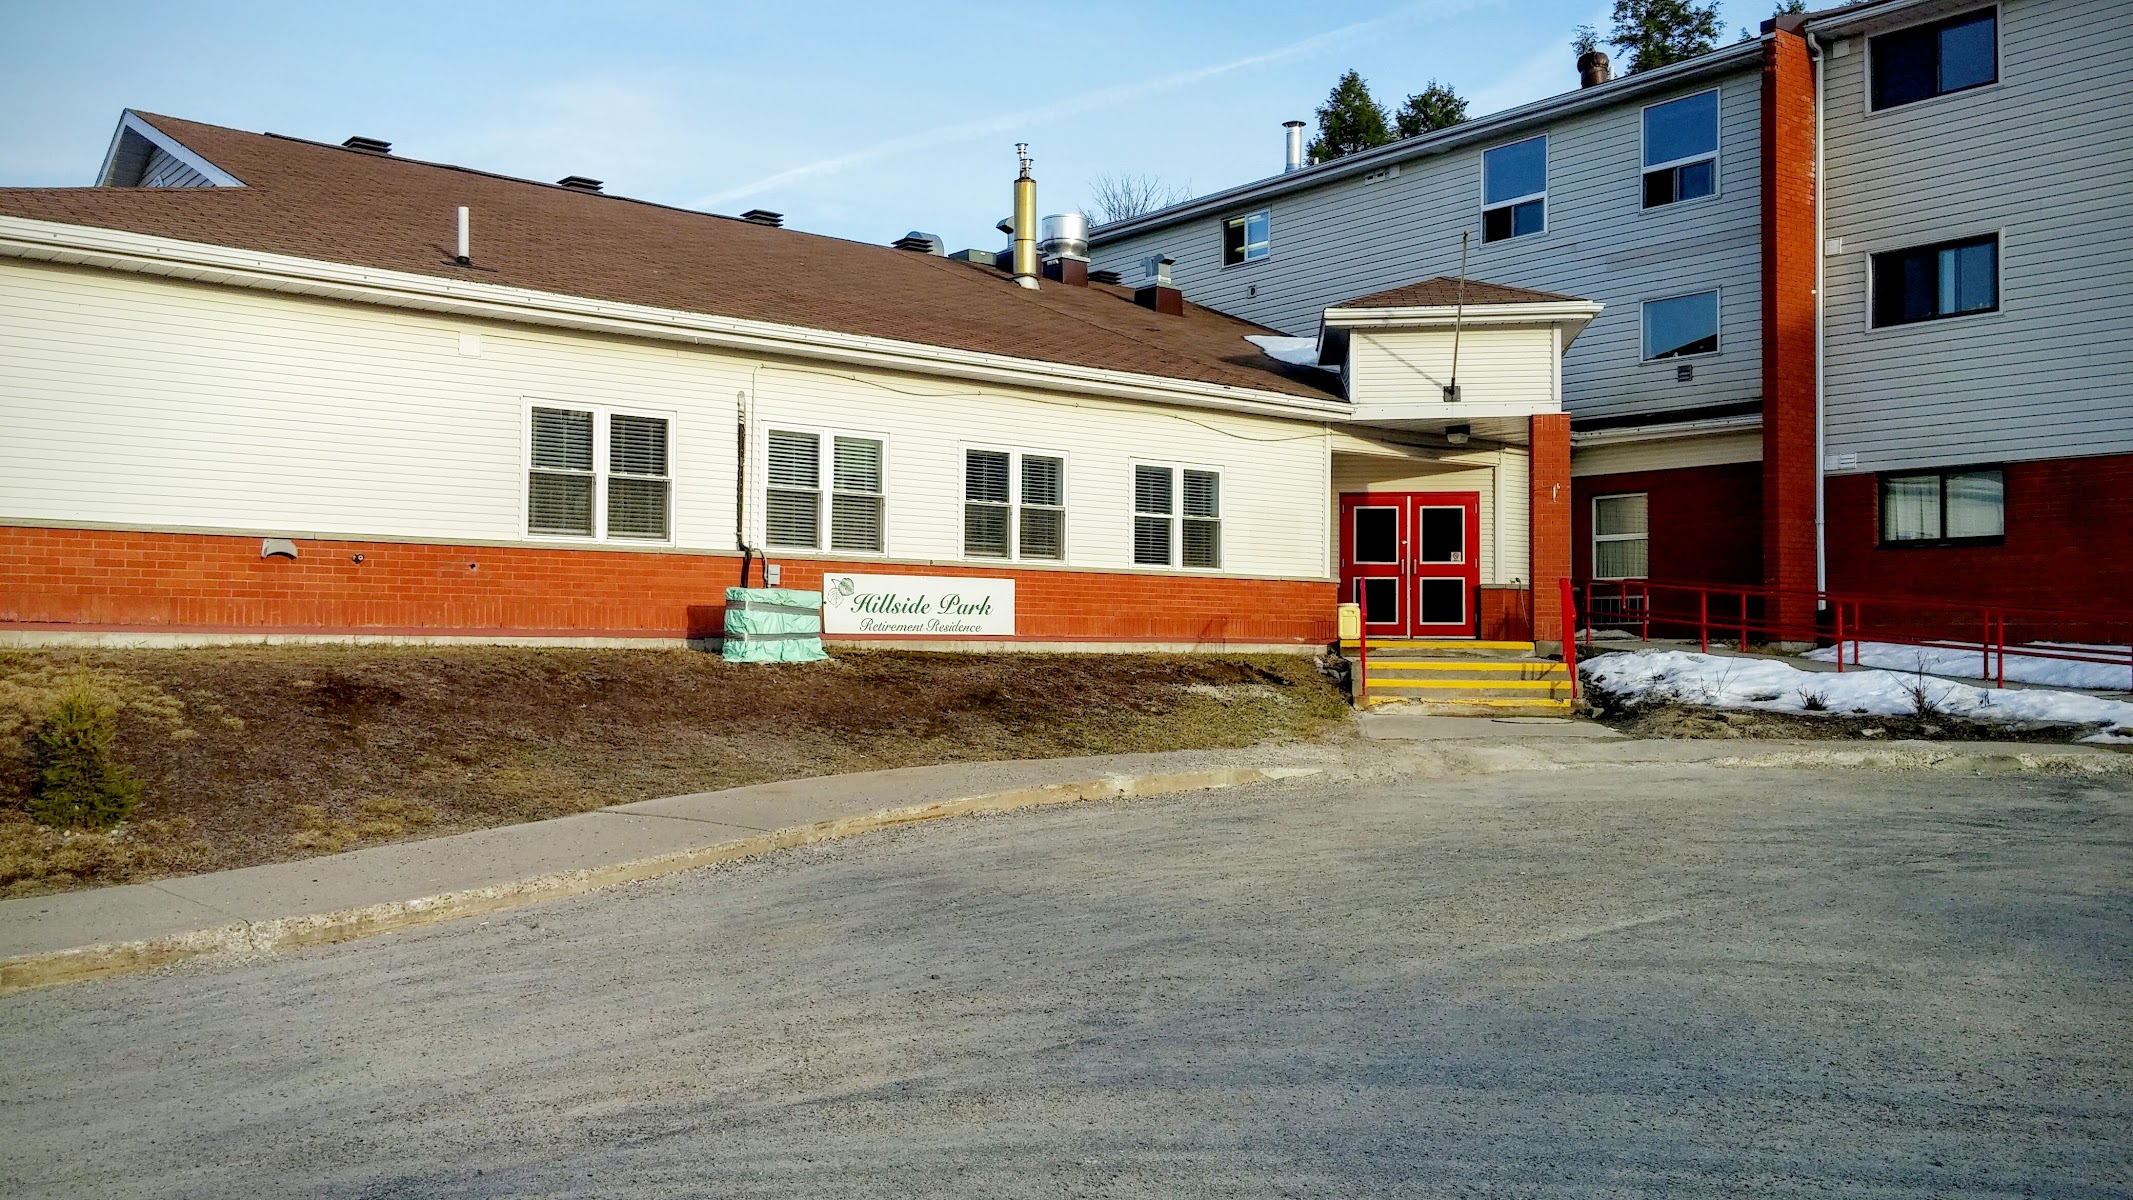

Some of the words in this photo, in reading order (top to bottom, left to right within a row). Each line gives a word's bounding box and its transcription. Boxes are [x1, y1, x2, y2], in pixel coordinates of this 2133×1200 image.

[851, 593, 931, 615] Hillside
[937, 593, 993, 616] Park
[859, 618, 924, 632] Retirement
[926, 618, 982, 633] Residence
